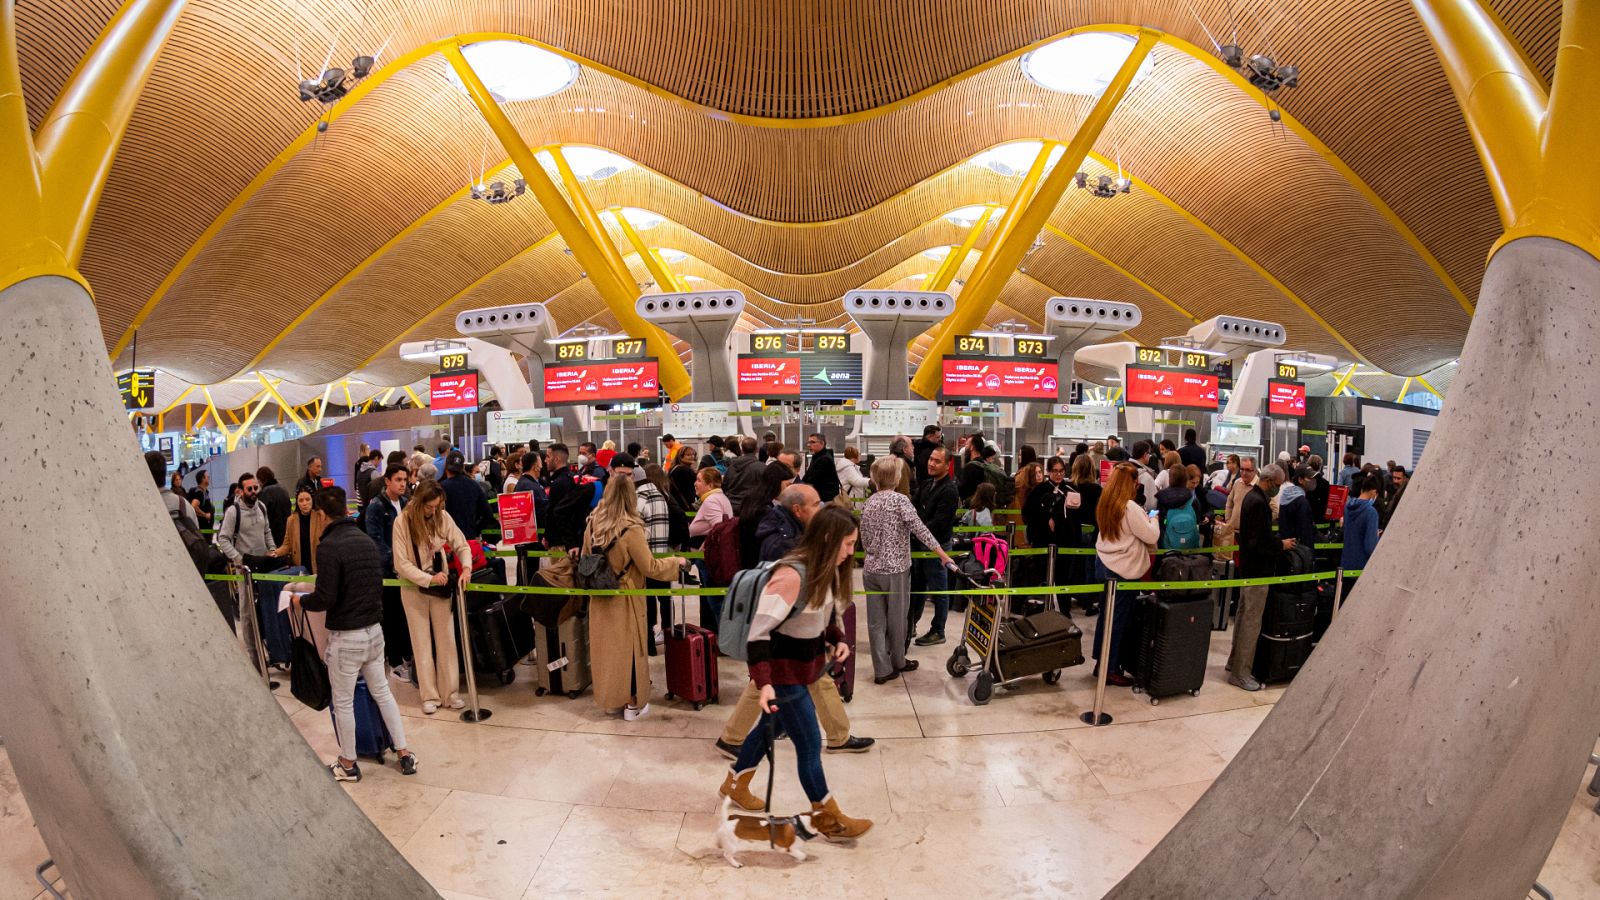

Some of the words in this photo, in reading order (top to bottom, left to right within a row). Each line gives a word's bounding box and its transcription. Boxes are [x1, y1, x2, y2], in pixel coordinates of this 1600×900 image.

[616, 341, 643, 355] 877
[754, 336, 782, 350] 876
[818, 336, 846, 350] 875
[959, 338, 985, 352] 874
[1018, 341, 1044, 355] 873
[559, 344, 584, 358] 878
[1139, 349, 1161, 363] 872
[443, 354, 465, 369] 879
[1186, 353, 1206, 367] 871
[830, 372, 850, 380] aena
[1279, 365, 1296, 378] 870
